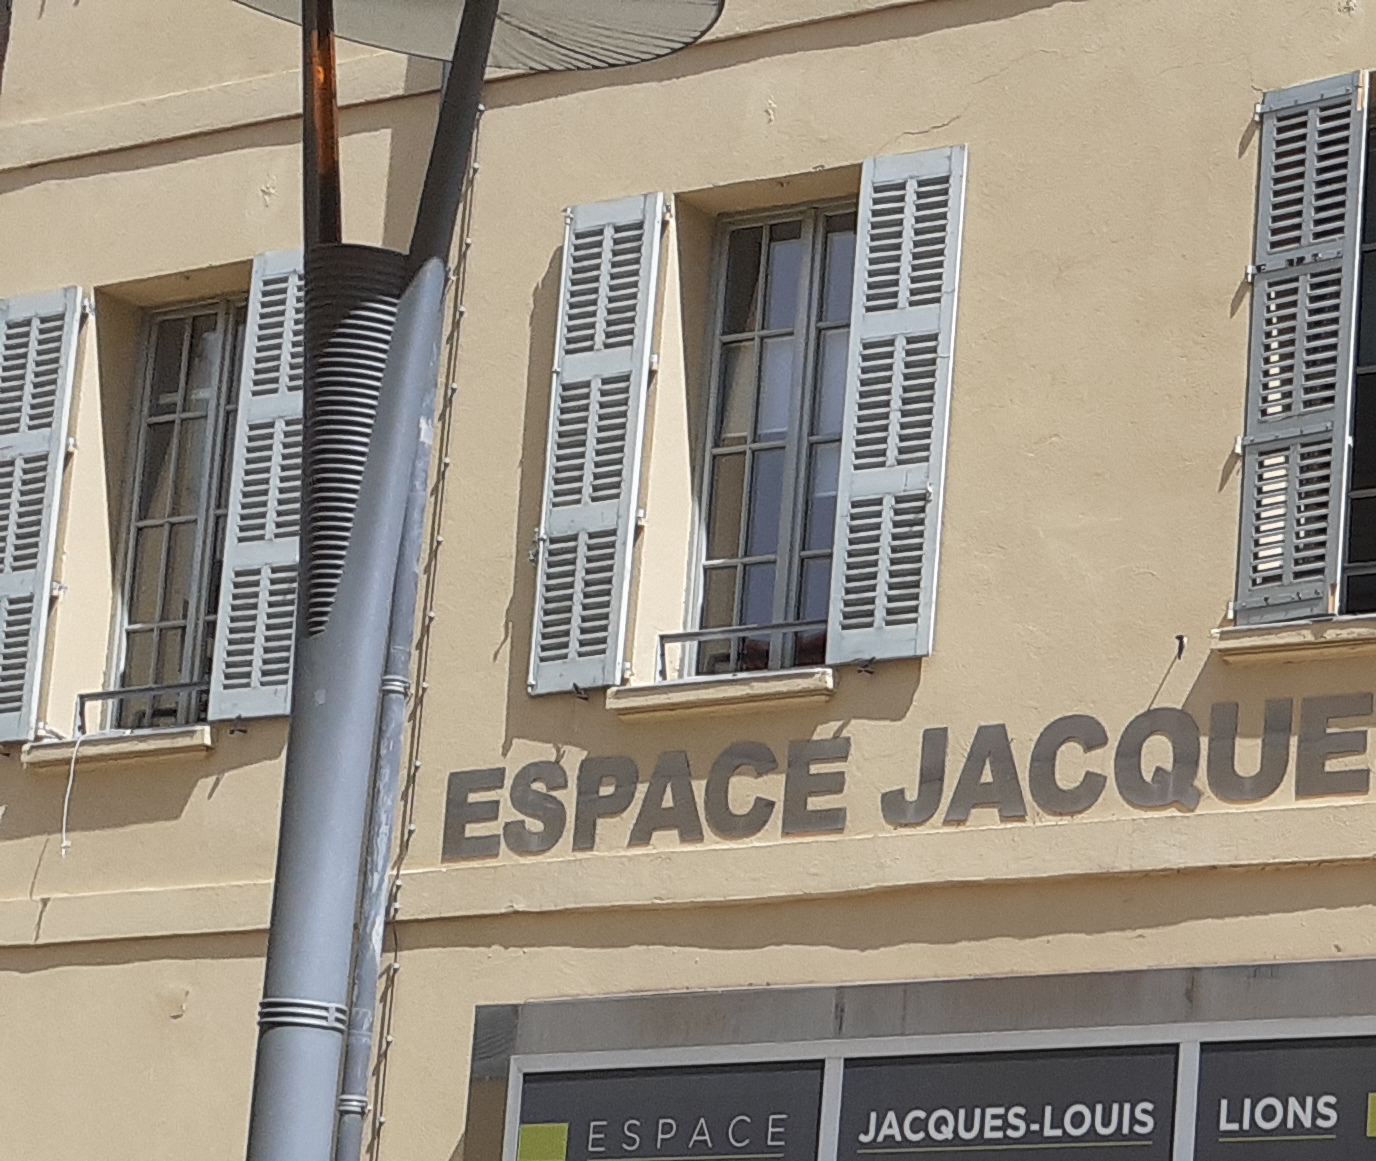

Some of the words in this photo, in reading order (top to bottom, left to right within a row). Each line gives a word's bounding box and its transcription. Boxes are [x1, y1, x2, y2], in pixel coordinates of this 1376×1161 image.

[441, 736, 851, 863] ESPACE
[587, 1114, 788, 1152] ESPACE
[857, 1101, 1155, 1144] JACQUES-LOUIS
[1219, 1095, 1338, 1132] LIONS
